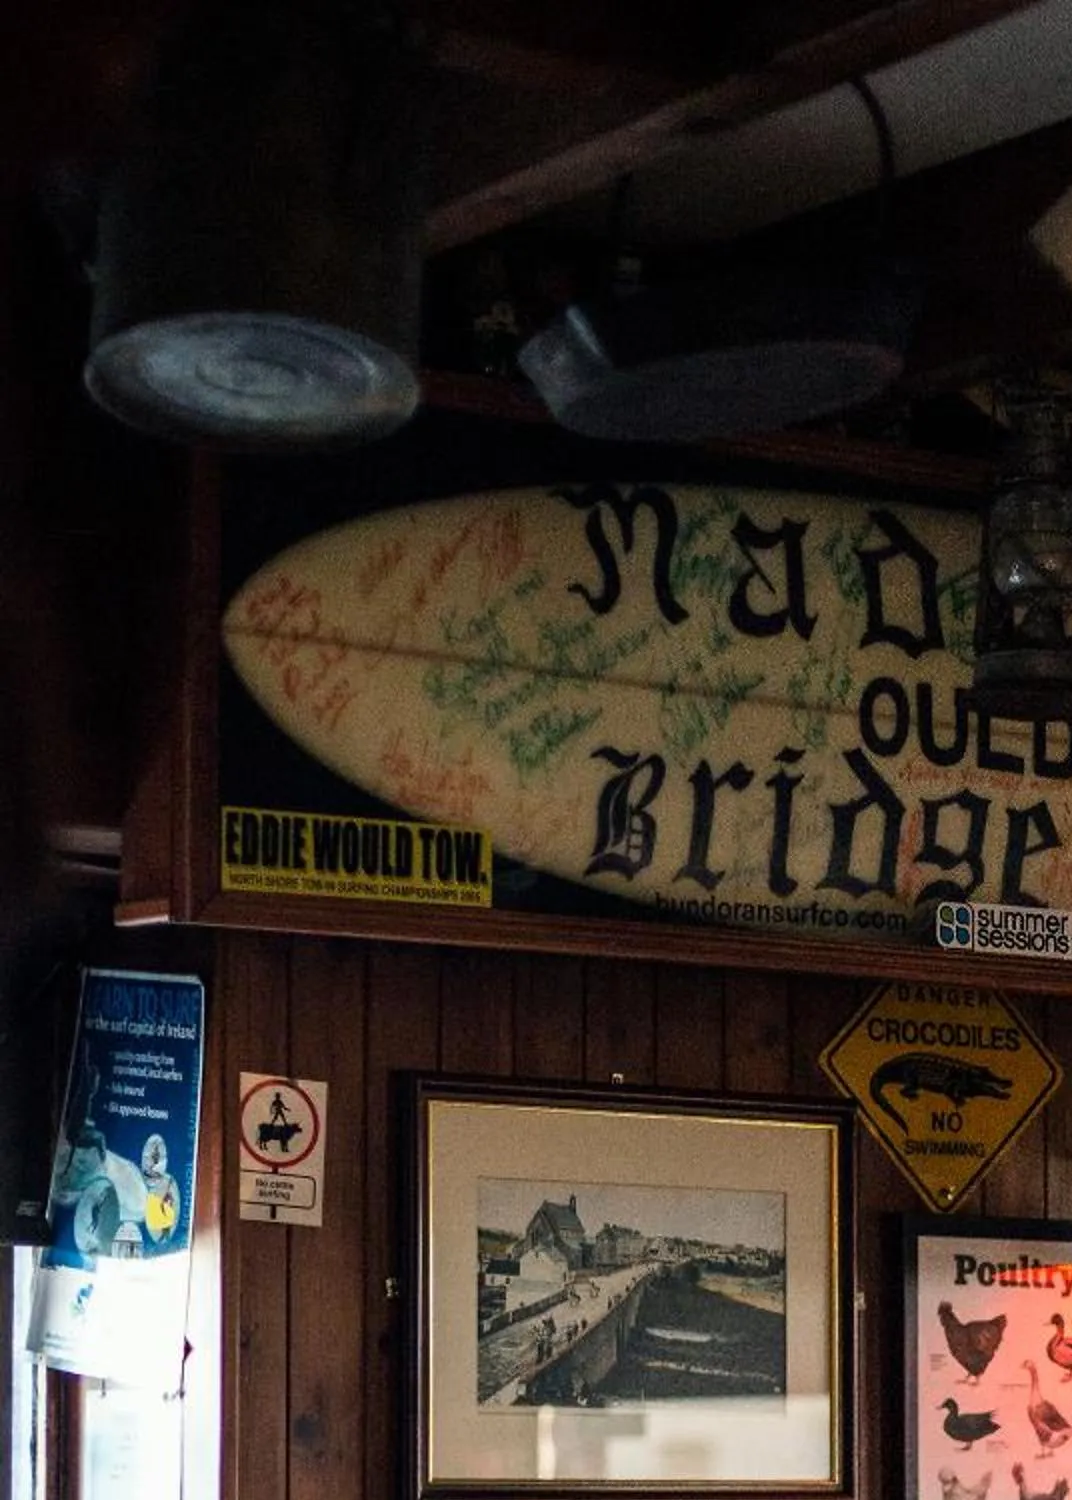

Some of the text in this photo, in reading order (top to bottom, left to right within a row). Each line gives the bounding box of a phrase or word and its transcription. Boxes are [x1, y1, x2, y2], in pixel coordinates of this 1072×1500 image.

[584, 747, 1062, 908] Bridge
[225, 811, 487, 884] EDDIE WOULD TOW.
[976, 908, 1069, 932] summer
[976, 928, 1070, 953] sessions
[898, 984, 990, 1008] DANGER
[866, 1016, 1021, 1050] CROCODILES
[931, 1112, 963, 1134] NO
